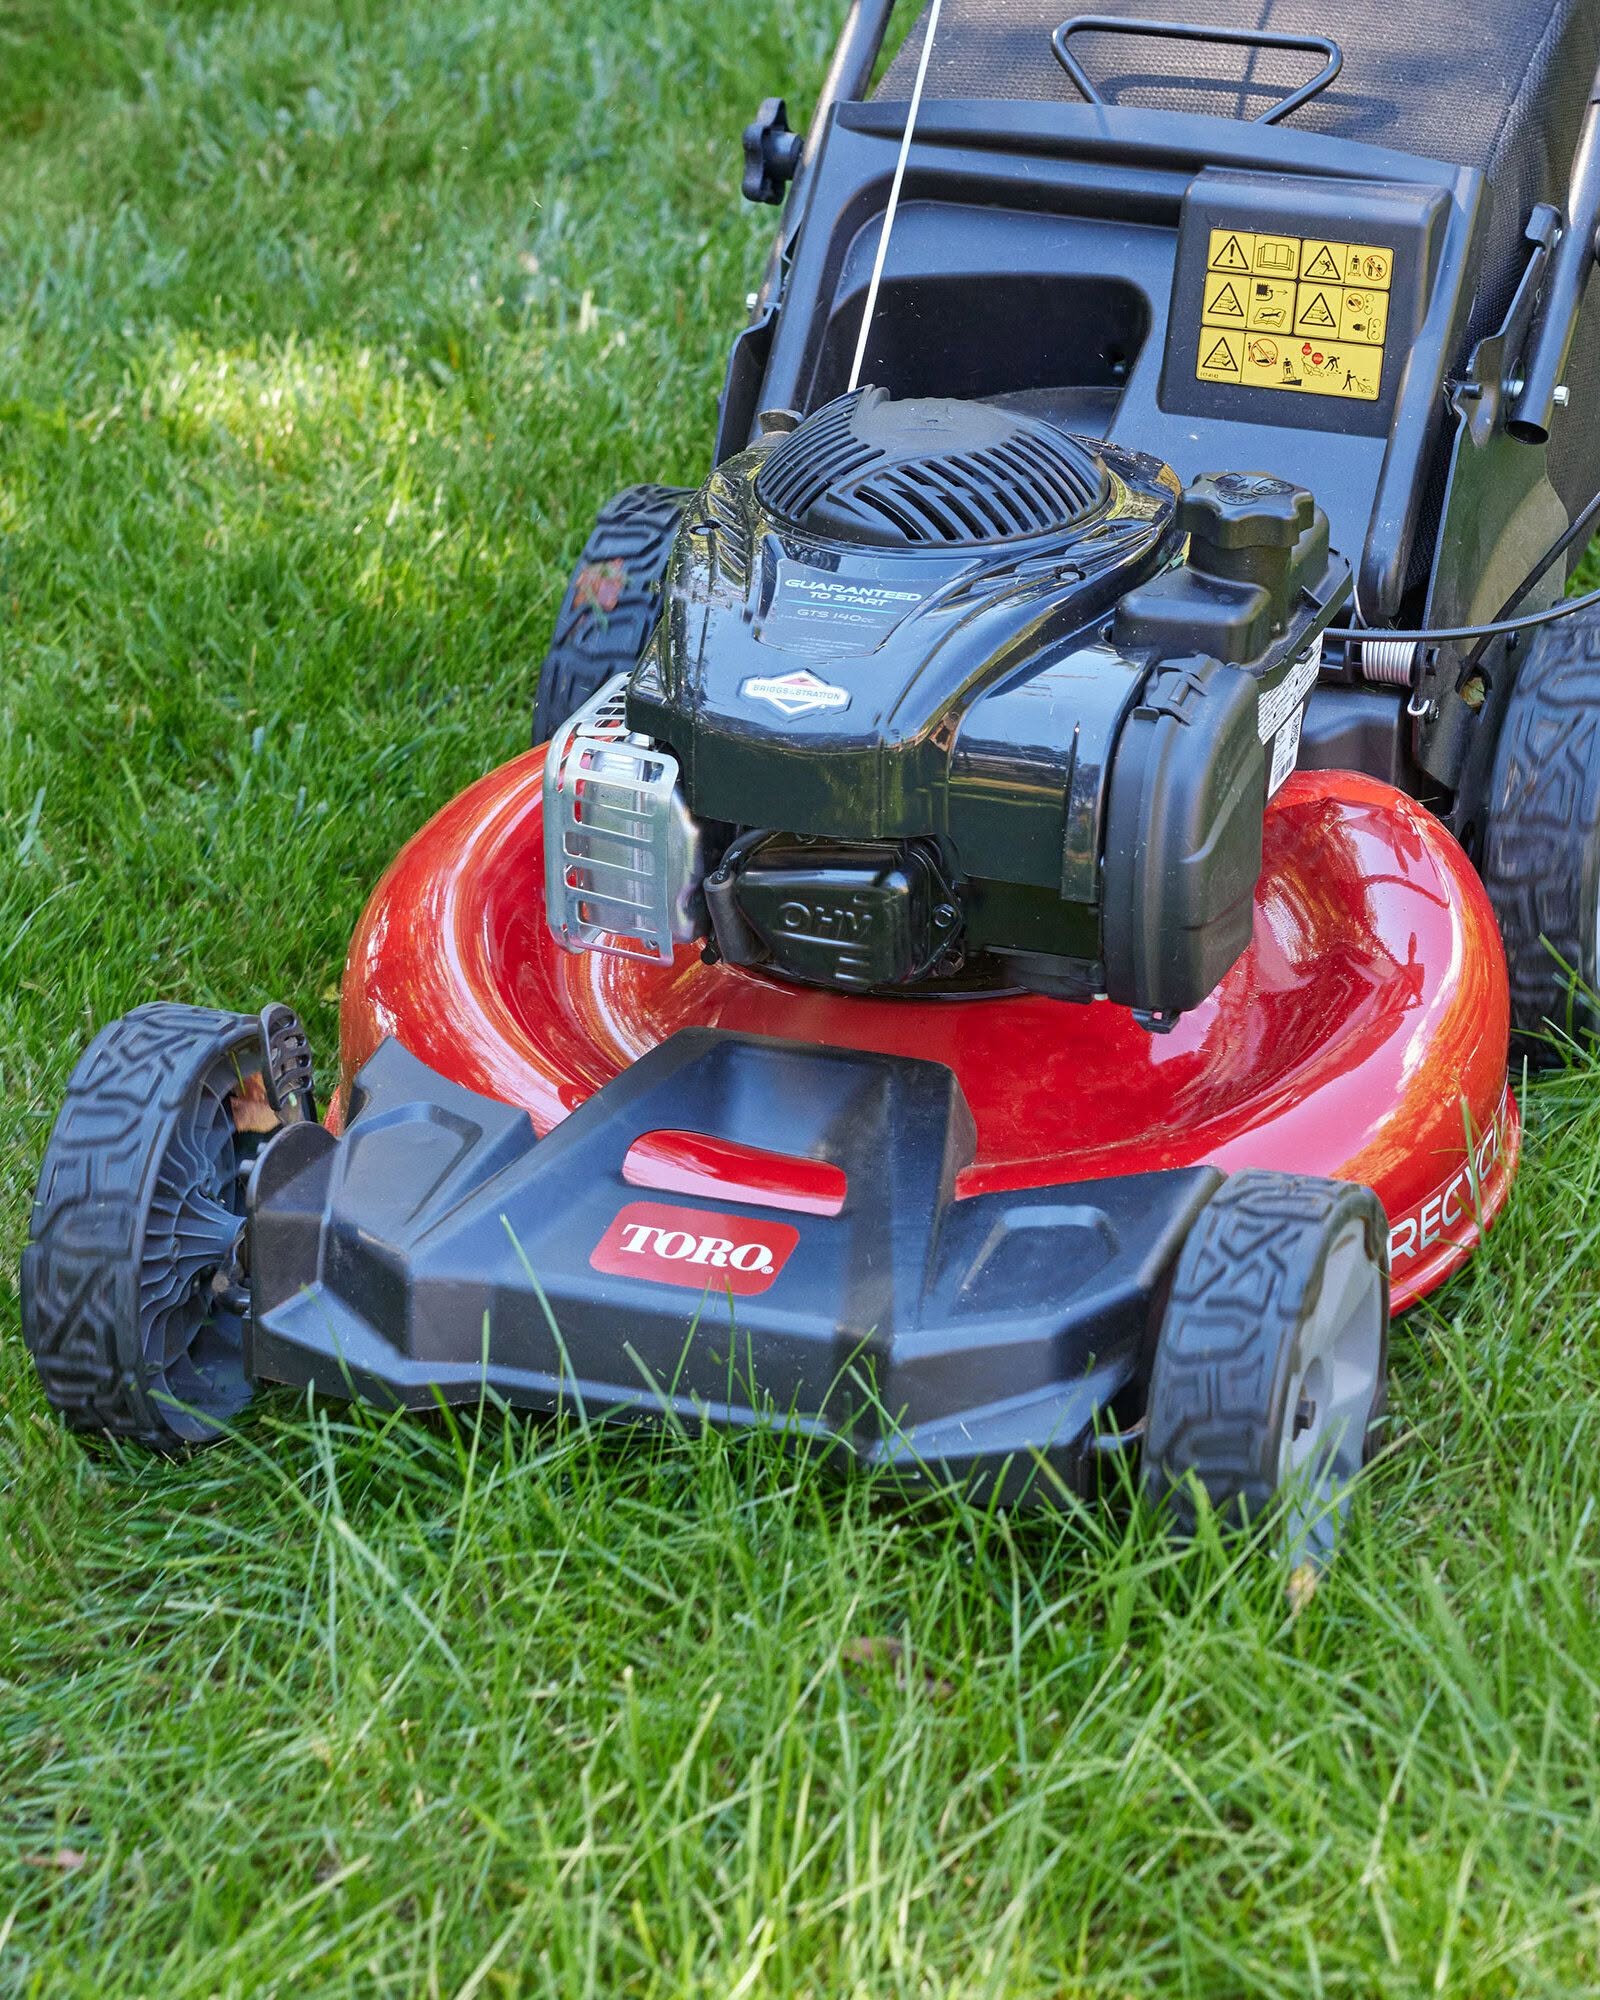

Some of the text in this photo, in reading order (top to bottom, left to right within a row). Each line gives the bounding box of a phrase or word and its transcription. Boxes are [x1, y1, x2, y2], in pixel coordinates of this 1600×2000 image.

[784, 579, 922, 601] GUARANTEED
[809, 591, 889, 607] TO START
[797, 608, 829, 618] GTS
[833, 612, 876, 624] 140cc
[752, 684, 789, 695] BRIGGS
[795, 689, 841, 700] STRATTON
[619, 1223, 773, 1272] TORO
